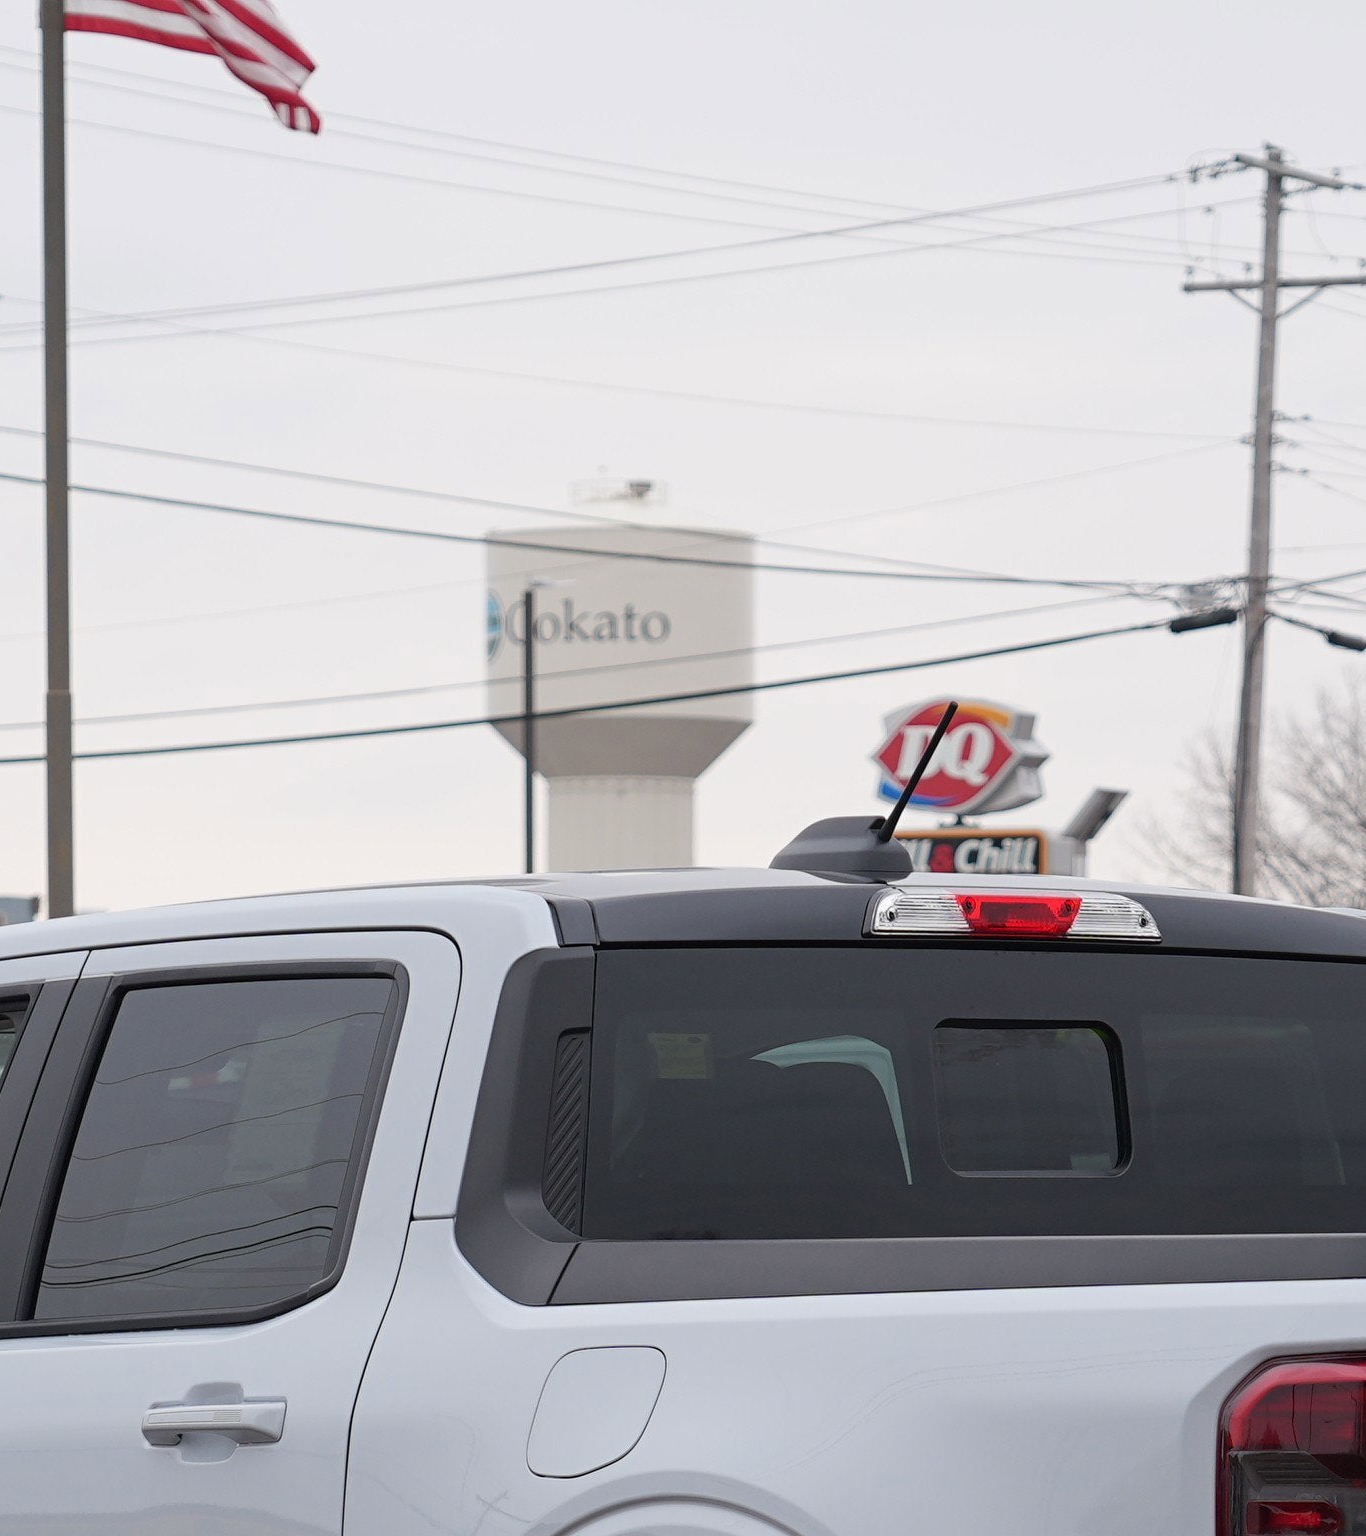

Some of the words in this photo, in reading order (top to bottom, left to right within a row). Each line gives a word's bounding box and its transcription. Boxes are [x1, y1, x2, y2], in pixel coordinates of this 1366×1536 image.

[506, 597, 672, 647] Cokato
[896, 722, 995, 787] DQ
[954, 837, 1037, 873] Chill
